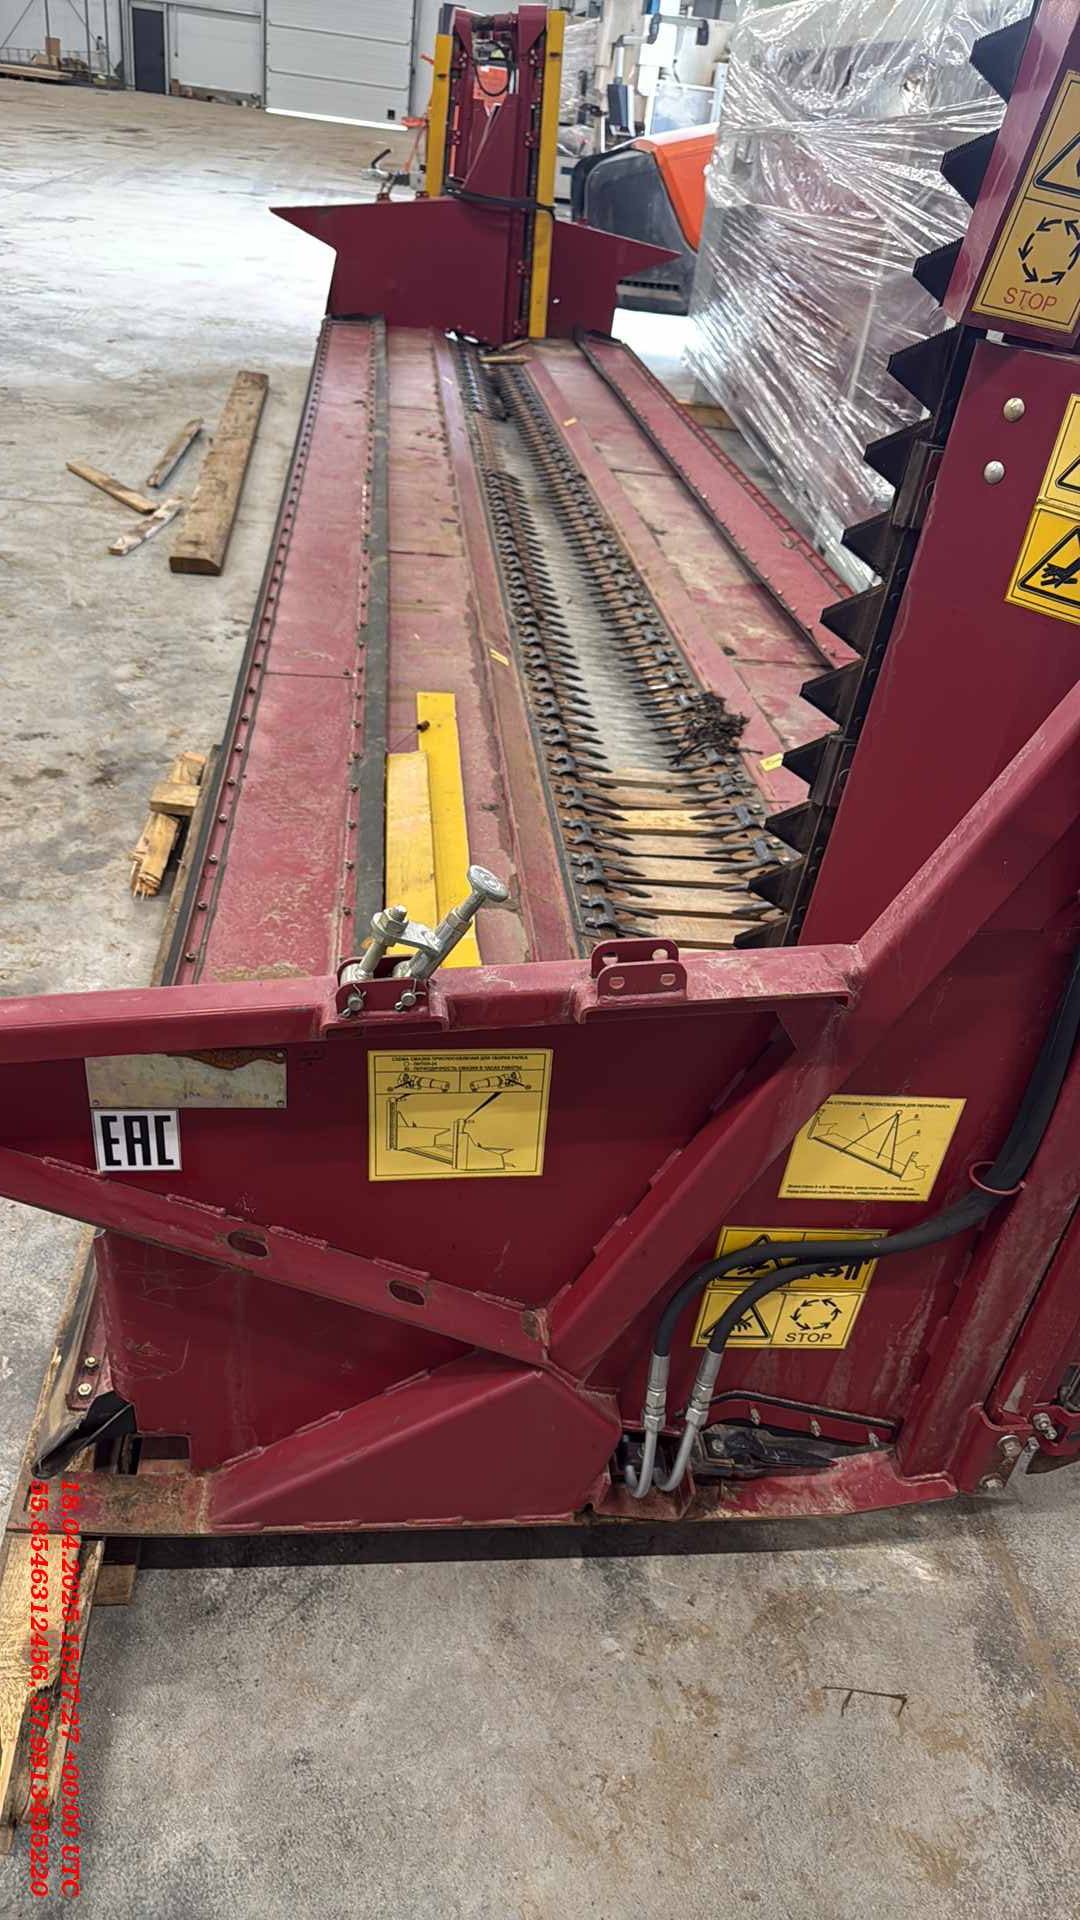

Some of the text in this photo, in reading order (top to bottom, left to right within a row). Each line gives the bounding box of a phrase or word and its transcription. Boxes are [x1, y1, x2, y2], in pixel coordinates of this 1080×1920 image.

[1003, 287, 1058, 312] STOP
[100, 1115, 174, 1166] EAC
[785, 1332, 832, 1343] STOP
